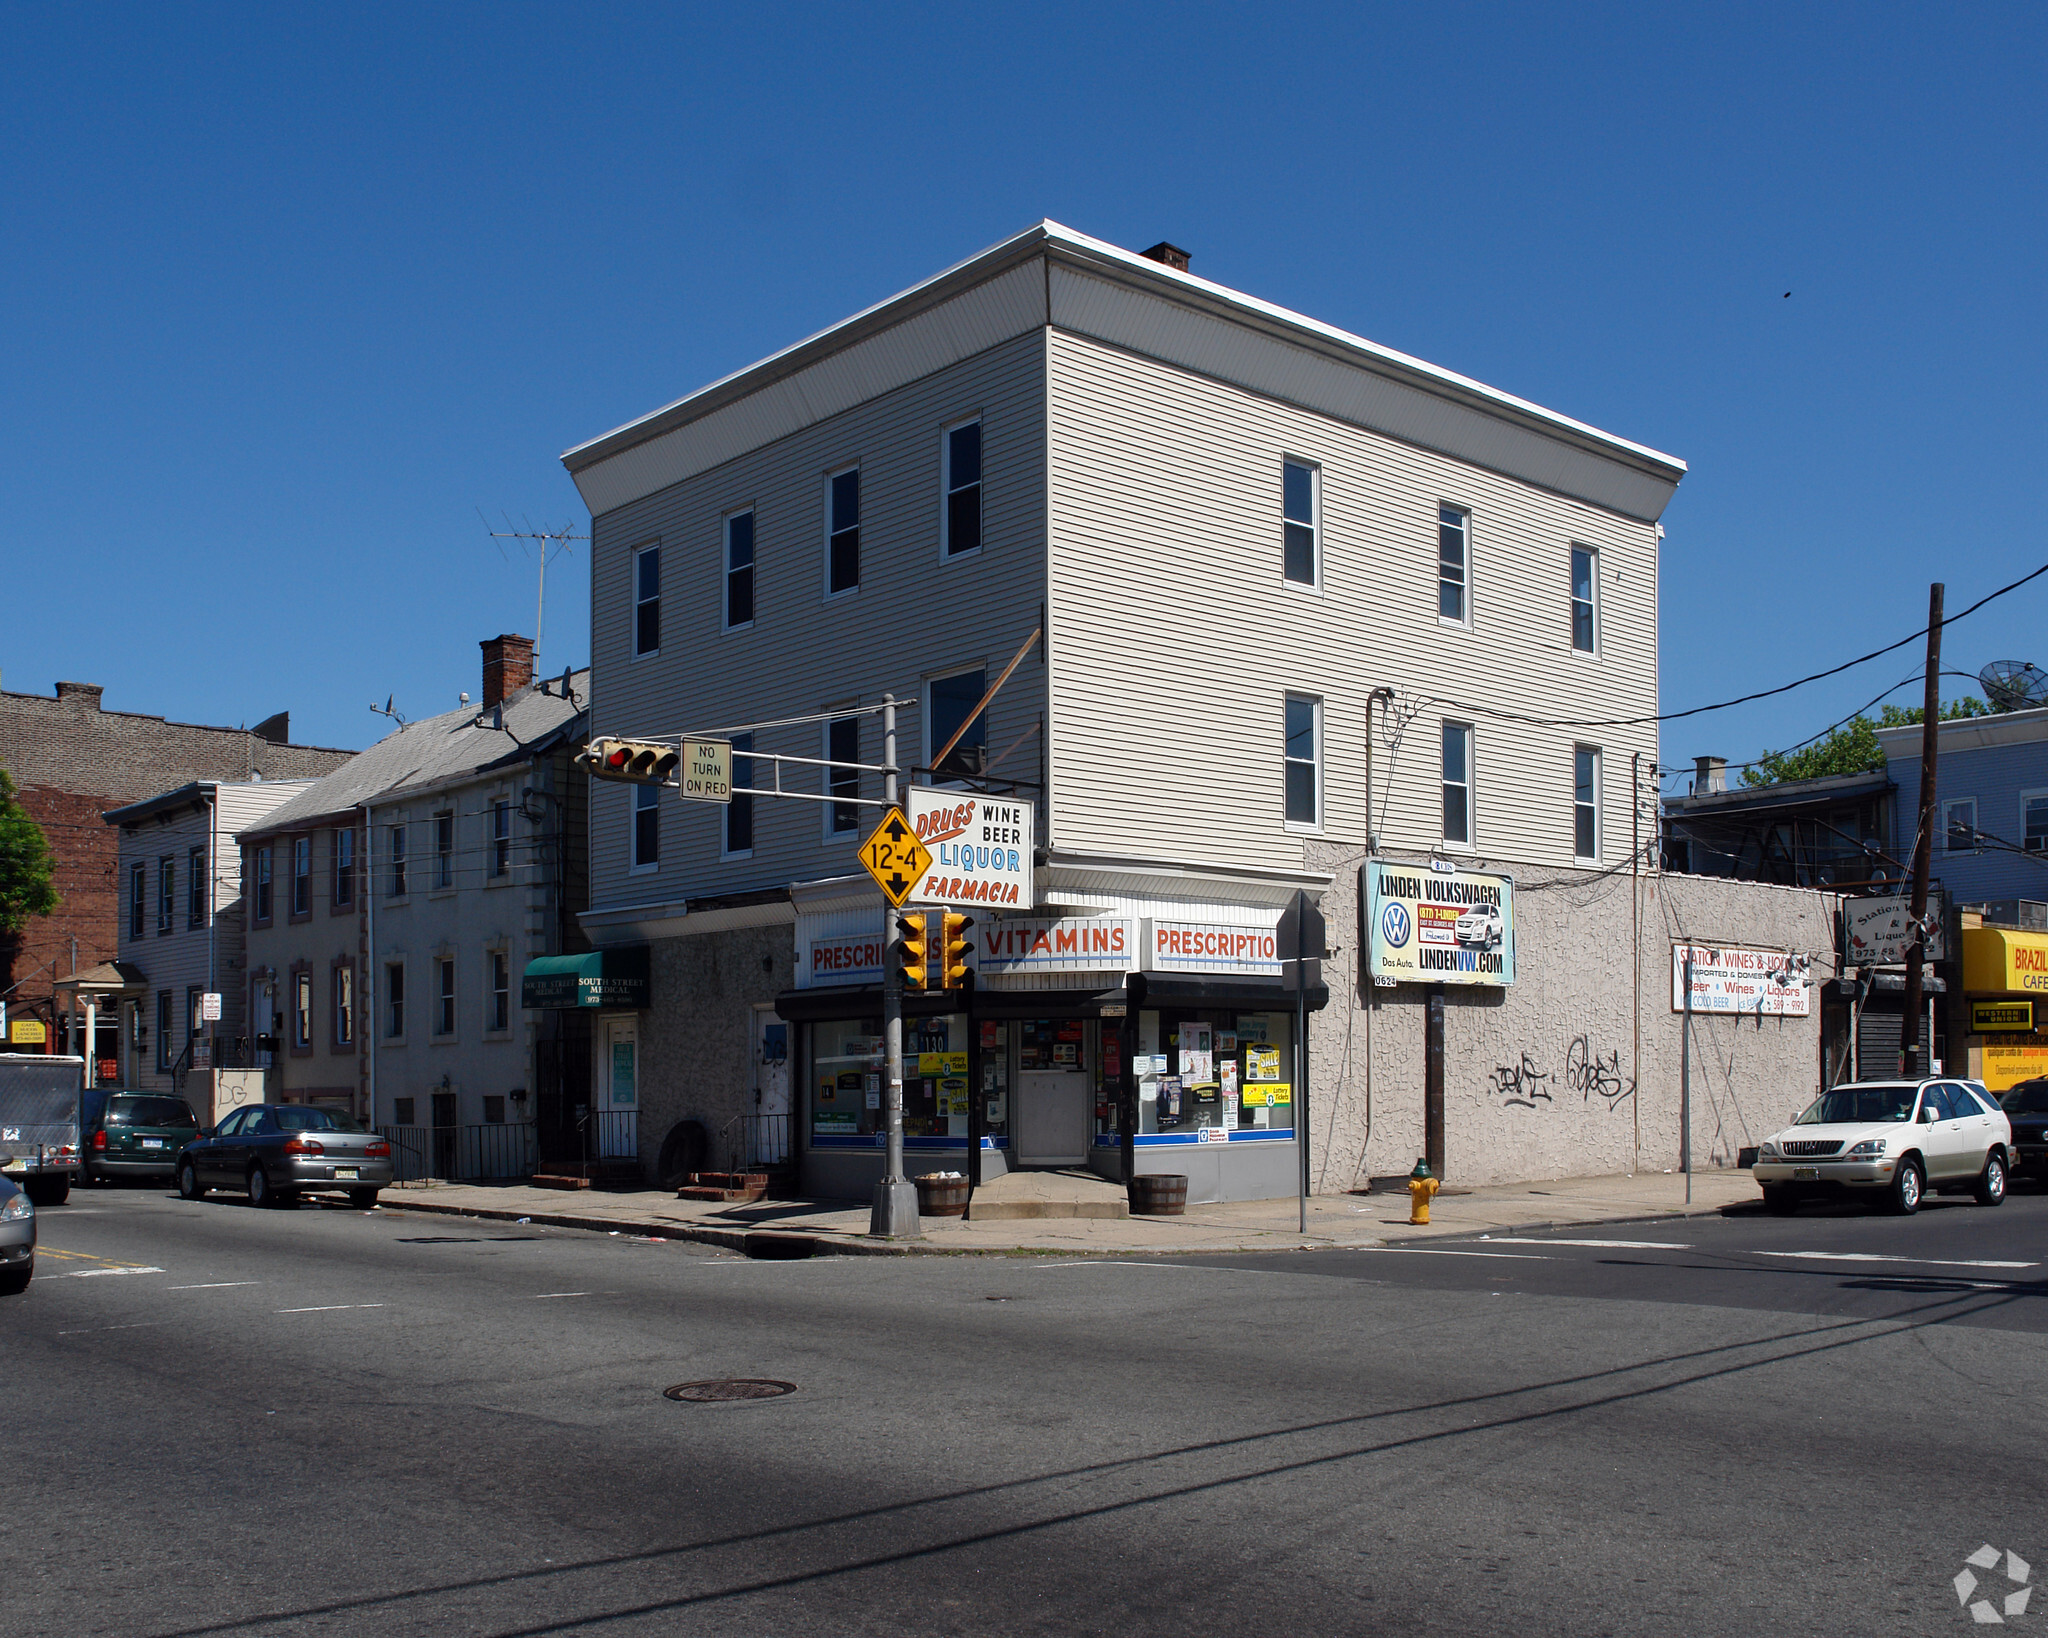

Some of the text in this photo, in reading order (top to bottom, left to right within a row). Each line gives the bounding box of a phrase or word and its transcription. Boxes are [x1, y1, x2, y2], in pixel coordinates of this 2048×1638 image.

[699, 745, 715, 759] NO
[692, 761, 721, 777] TURN
[686, 779, 727, 795] ON RED
[915, 800, 976, 840] DRUGS
[982, 804, 1021, 825] WINE
[982, 826, 1021, 845] BEER
[940, 843, 1020, 872] LIQUOR
[923, 875, 1020, 904] FARMACIA
[1380, 874, 1502, 908] LINDEN VOLKSWAGEN
[1858, 904, 1900, 926] Station
[1890, 919, 1900, 928] &
[985, 927, 1126, 955] VITAMINS
[1157, 929, 1276, 959] PRESCRIPTIO
[1382, 957, 1414, 969] Das Auto.
[1419, 948, 1504, 974] LINDENVW.COM
[1680, 949, 1721, 967] STATION
[1723, 951, 1755, 969] WINES
[1757, 955, 1765, 970] &
[578, 977, 644, 987] SOUTH STREET
[1375, 974, 1397, 986] 0624
[589, 985, 630, 995] MEDICAL
[1724, 981, 1755, 995] Wines
[1767, 983, 1800, 999] Liquors
[1713, 995, 1730, 1009] BEER
[1977, 1010, 2019, 1018] WESTERN
[1260, 1051, 1280, 1068] SALE
[1273, 1087, 1288, 1095] Lottery
